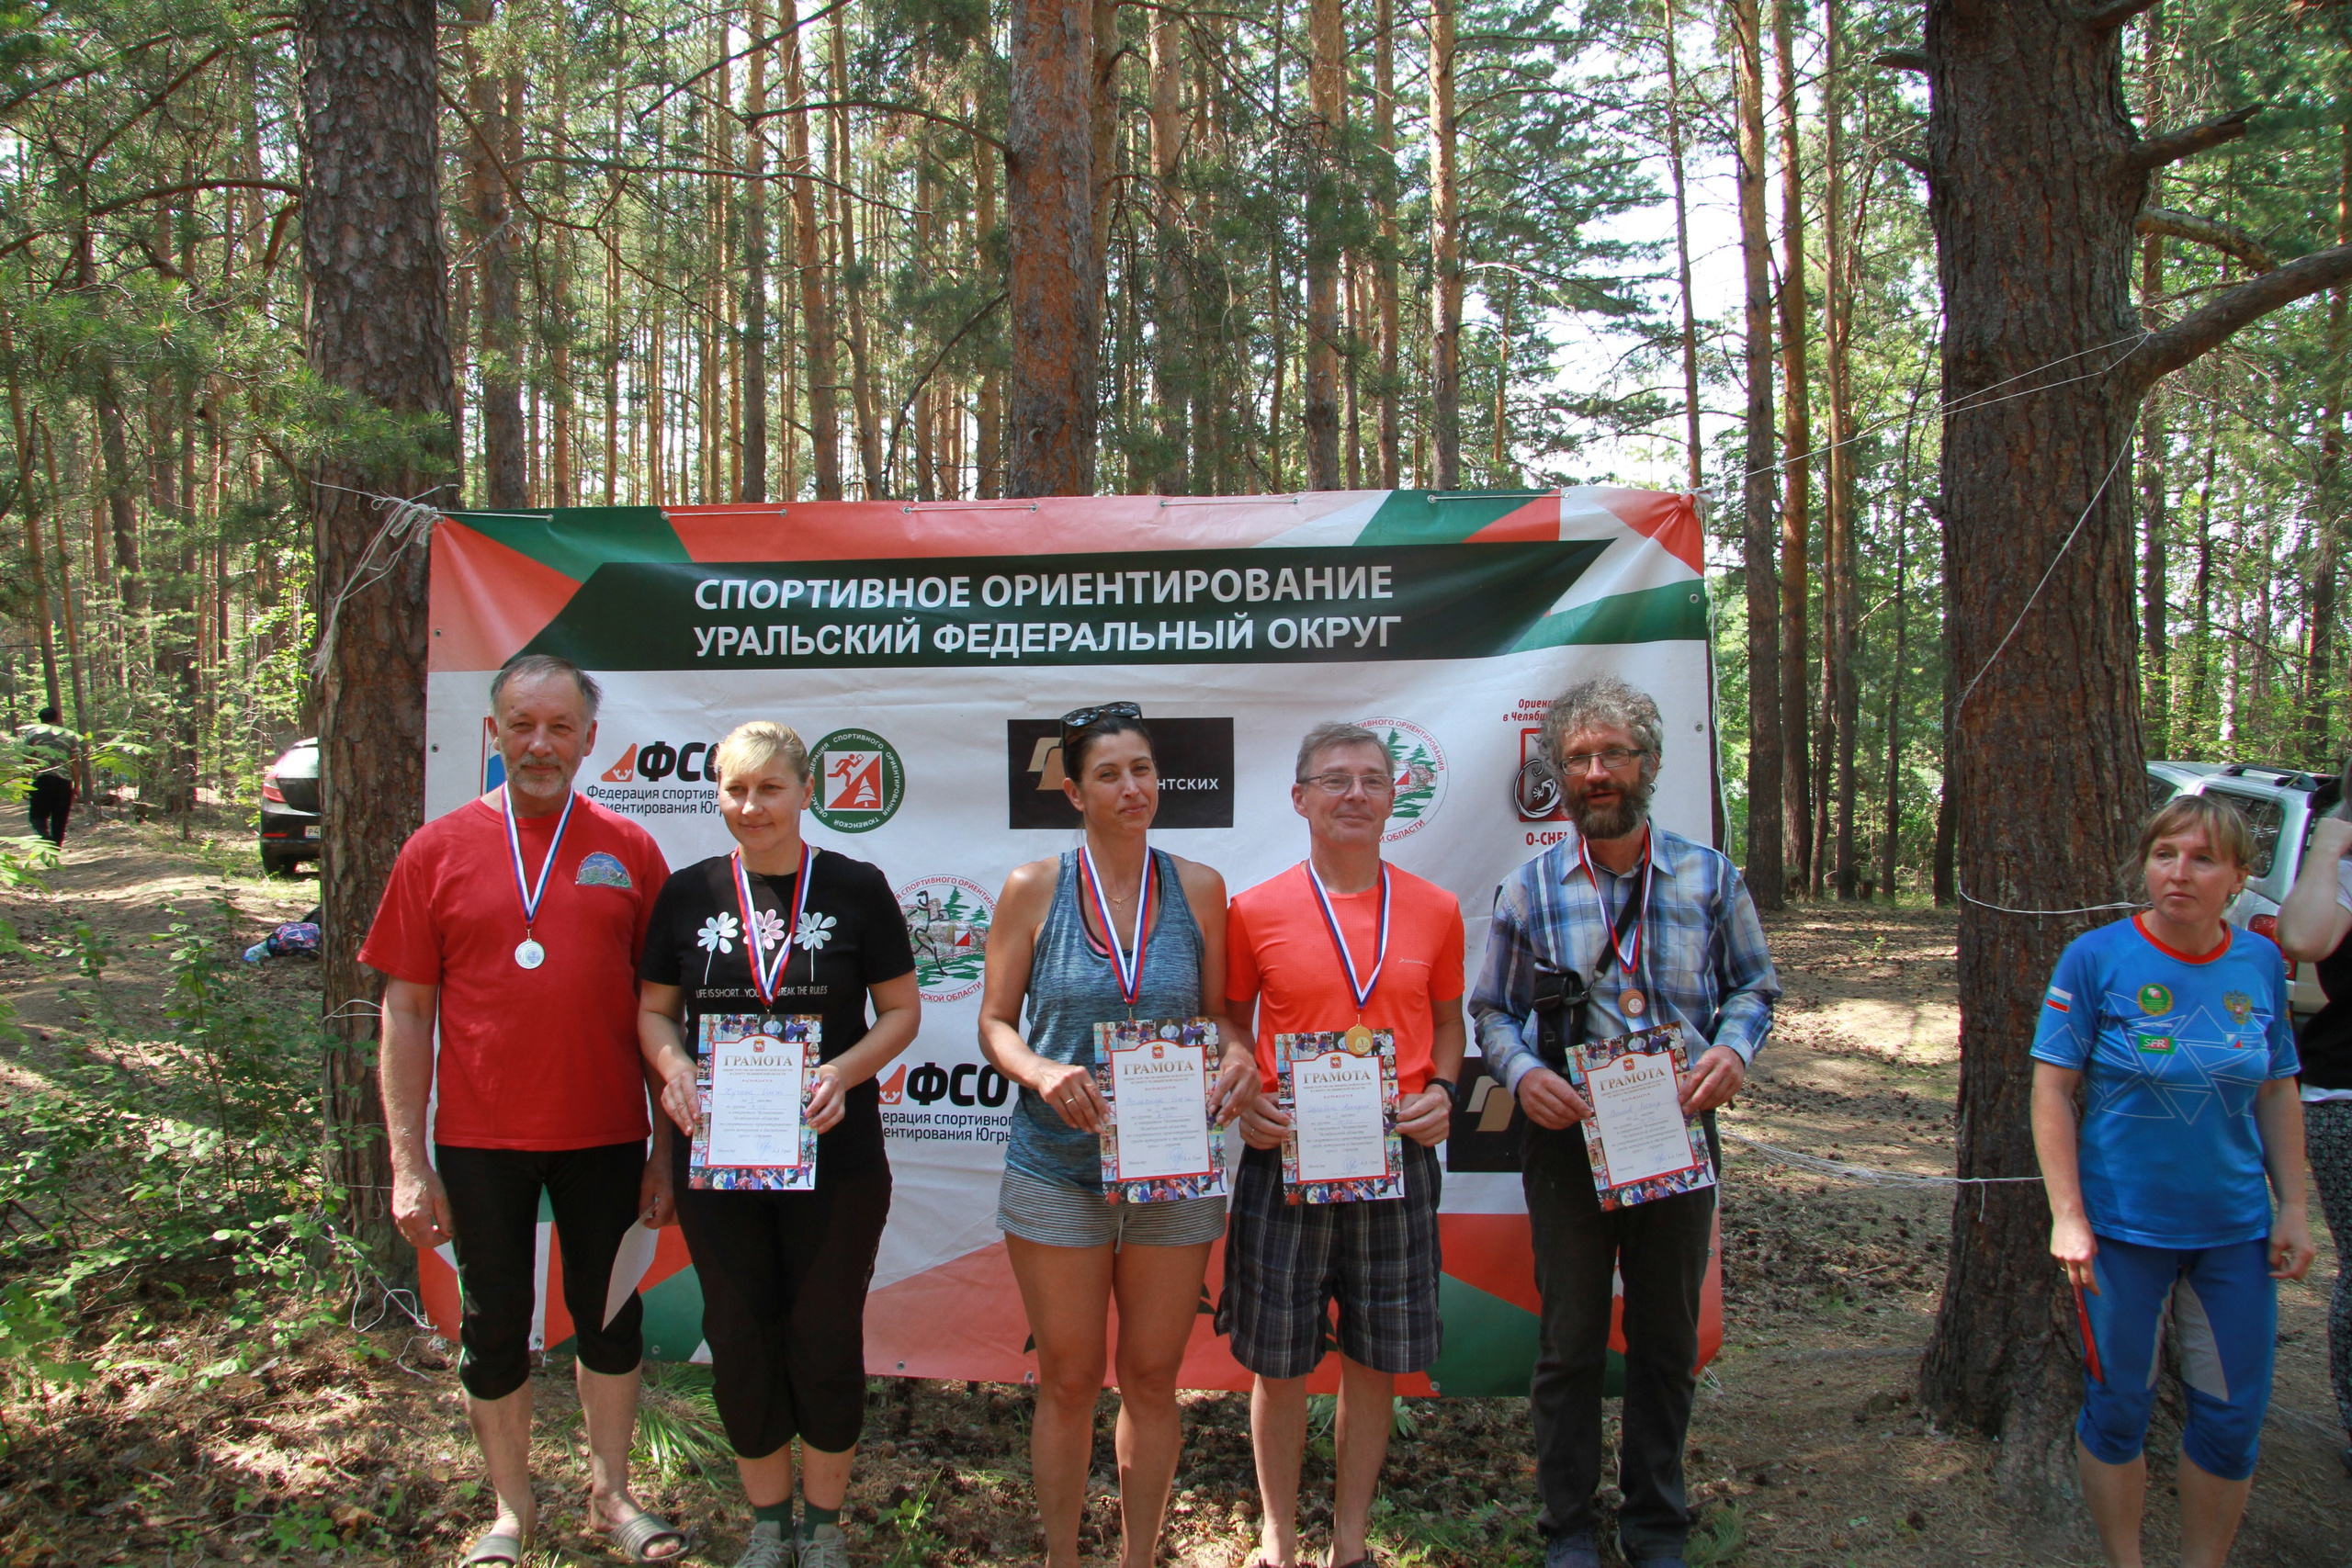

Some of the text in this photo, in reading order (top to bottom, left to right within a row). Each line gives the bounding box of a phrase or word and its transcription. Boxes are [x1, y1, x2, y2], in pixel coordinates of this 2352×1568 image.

[694, 565, 1394, 610] СПОРТИВНОЕ ОРИЕНТИРОВАНИЕ
[693, 611, 1403, 660] УРАЛЬСКИЙ ФЕДЕРАЛЬНЫЙ ОКРУГ
[1502, 710, 1548, 722] в Челяби
[1356, 718, 1445, 772] ТИВНОГО ОРИЕНТИРОВАНИЯ
[809, 733, 900, 816] ДЕРАЦИЯ СПОРТИВНОГО ОРИЕНТИРОВАНИЯ
[1157, 778, 1219, 790] НТСКИХ
[587, 784, 660, 802] Федерация
[599, 802, 697, 817] иентирования
[810, 789, 880, 829] ТЮМЕНСКОЙ ОБЛАС
[1386, 819, 1425, 842] ОБЛАСТИ
[1525, 831, 1567, 846] O-CHE
[901, 876, 996, 912] СПОРТИВНОГО ОРИЕНТИРО
[695, 988, 707, 998] LIFE
[707, 988, 715, 998] IS
[797, 986, 808, 995] THE
[809, 986, 828, 995] RULES
[919, 981, 983, 1002] НСКОЙ ОБЛАСТИ
[2143, 1038, 2166, 1047] SFR
[724, 1055, 793, 1066] ГРАМОТА
[1123, 1061, 1193, 1075] ГРАМОТА
[907, 1062, 1010, 1108] ФСО
[1303, 1070, 1371, 1084] ГРАМОТА
[1599, 1067, 1665, 1091] ГРАМОТА
[879, 1112, 1012, 1128] ерация спортивног
[883, 1127, 972, 1143] ентирования
